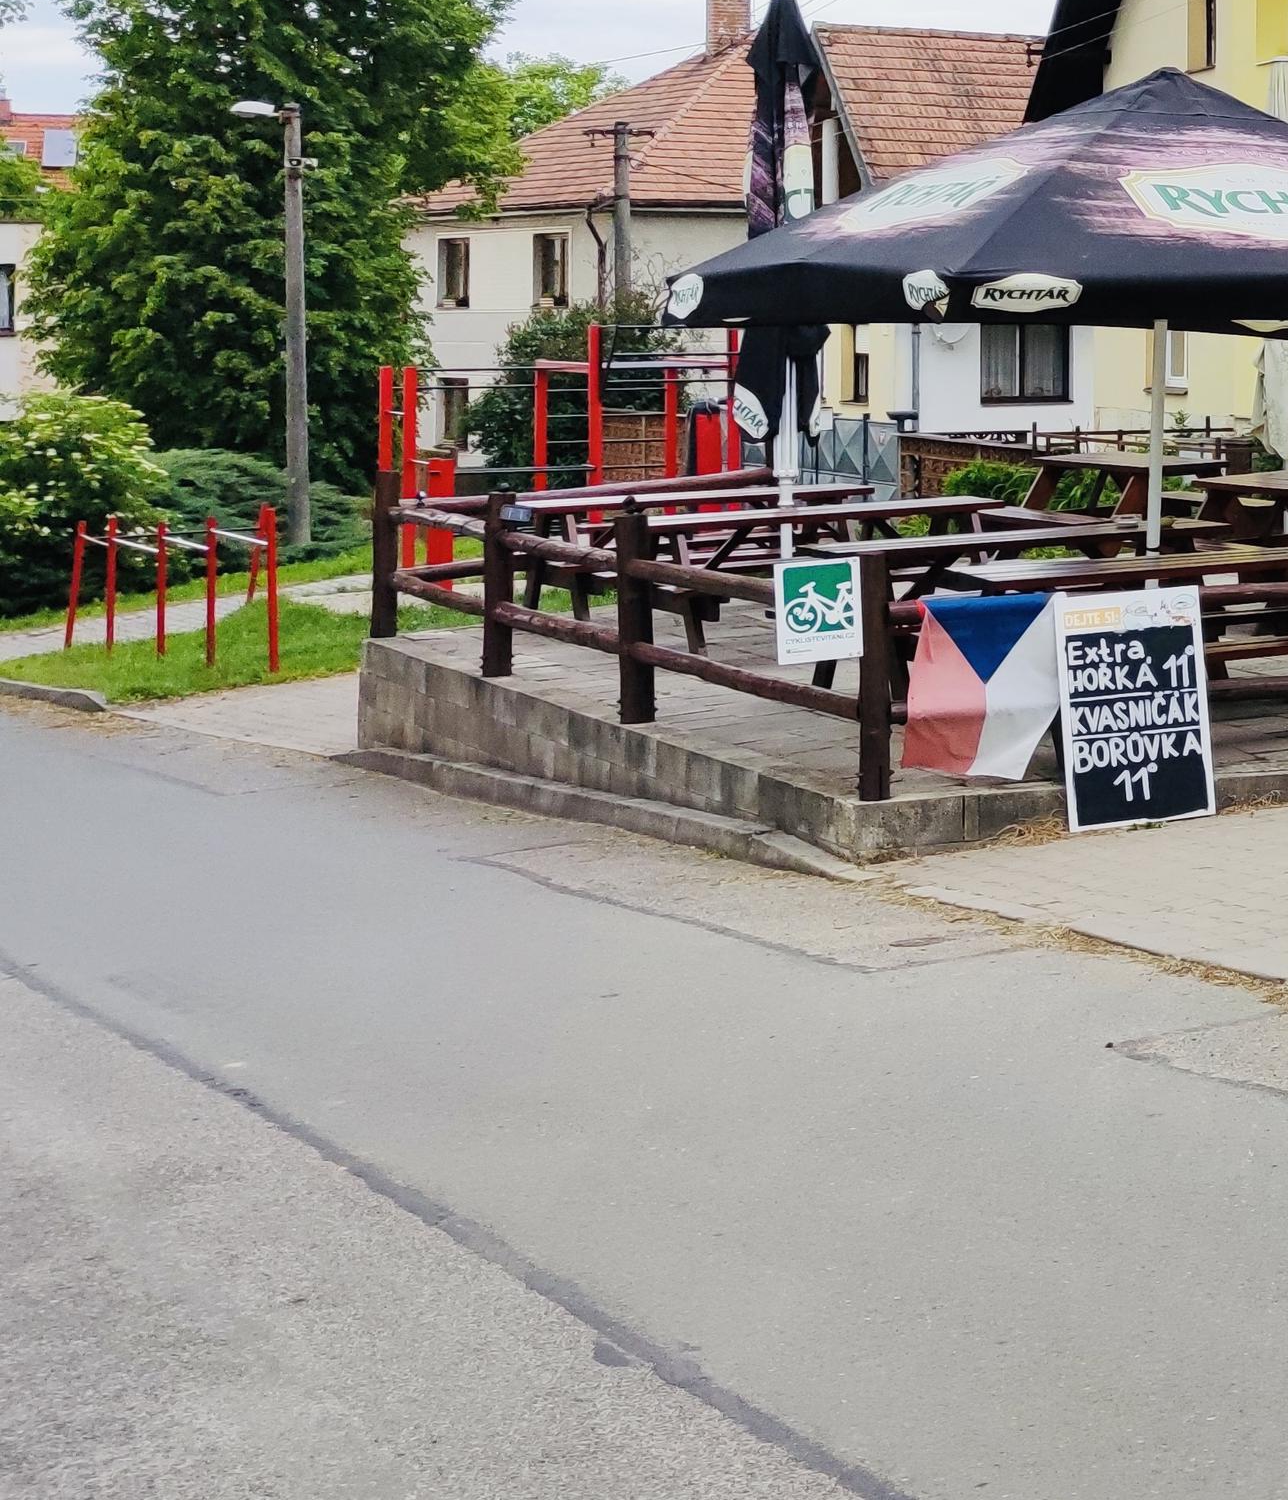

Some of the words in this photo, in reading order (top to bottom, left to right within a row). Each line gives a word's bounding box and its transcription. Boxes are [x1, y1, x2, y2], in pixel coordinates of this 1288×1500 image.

[982, 286, 1070, 303] RYCHTÁŘ
[1065, 610, 1101, 628] DEJTE
[1067, 638, 1146, 667] Extra
[1070, 690, 1200, 736] KVASNIČÁK
